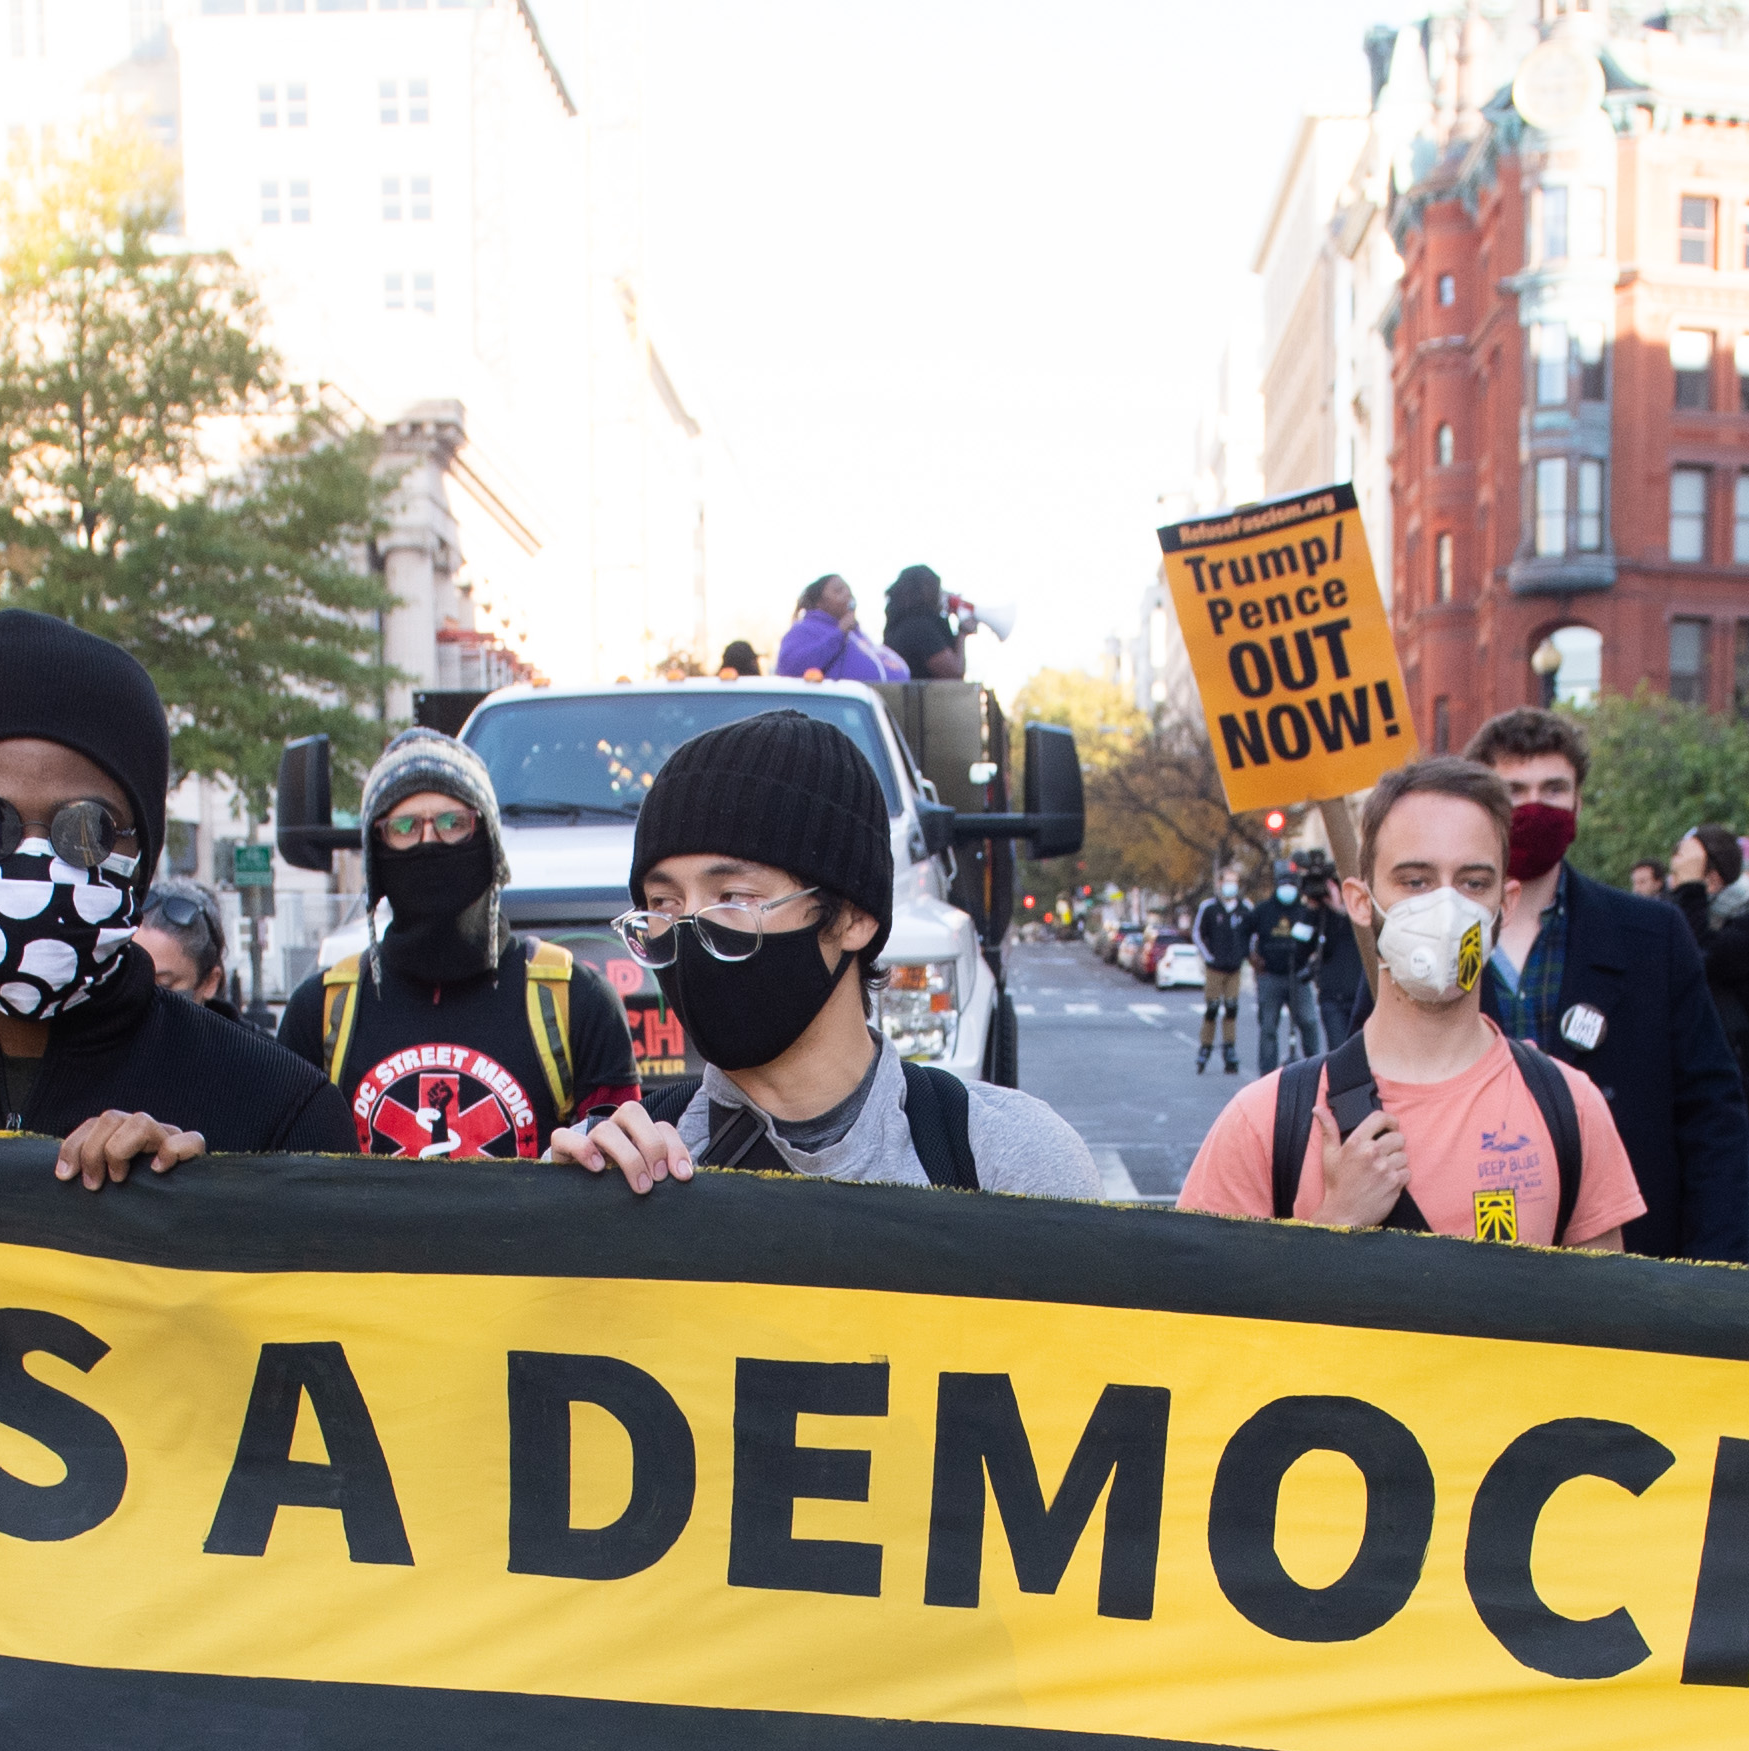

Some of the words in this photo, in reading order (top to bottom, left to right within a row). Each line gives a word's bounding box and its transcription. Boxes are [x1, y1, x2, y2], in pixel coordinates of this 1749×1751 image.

[1184, 519, 1343, 594] Trump/
[1206, 577, 1349, 636] Pence
[1228, 617, 1351, 699] OUT
[1218, 679, 1400, 770] NOW!
[354, 1082, 378, 1120] DC
[375, 1046, 469, 1085] STREET
[470, 1056, 535, 1129] MEDIC
[202, 1340, 415, 1567] A
